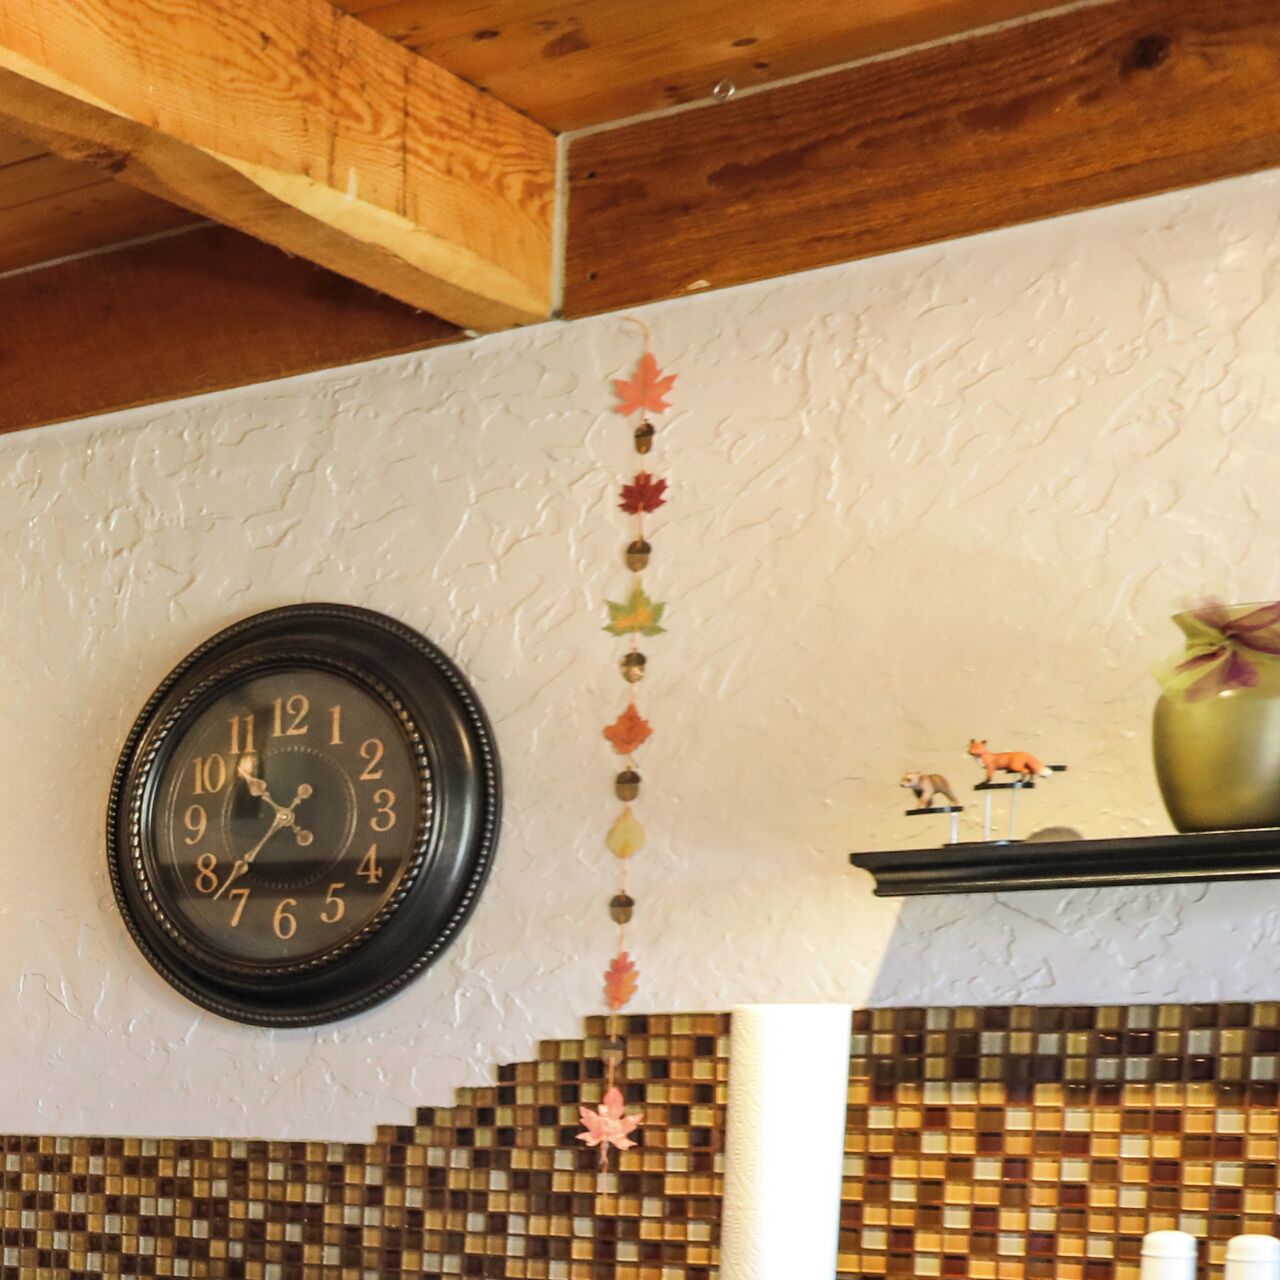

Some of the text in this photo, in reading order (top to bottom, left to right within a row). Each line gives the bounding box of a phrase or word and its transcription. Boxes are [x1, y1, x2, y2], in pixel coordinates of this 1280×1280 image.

[229, 714, 255, 754] 11
[271, 694, 310, 738] 12
[329, 705, 342, 745] 1
[192, 753, 226, 795] 10
[359, 738, 384, 780] 2
[184, 805, 207, 844] 9
[370, 789, 396, 832] 3
[195, 854, 218, 892] 8
[356, 844, 382, 884] 4
[229, 888, 250, 927] 7
[273, 898, 297, 939] 6
[320, 882, 345, 923] 5
